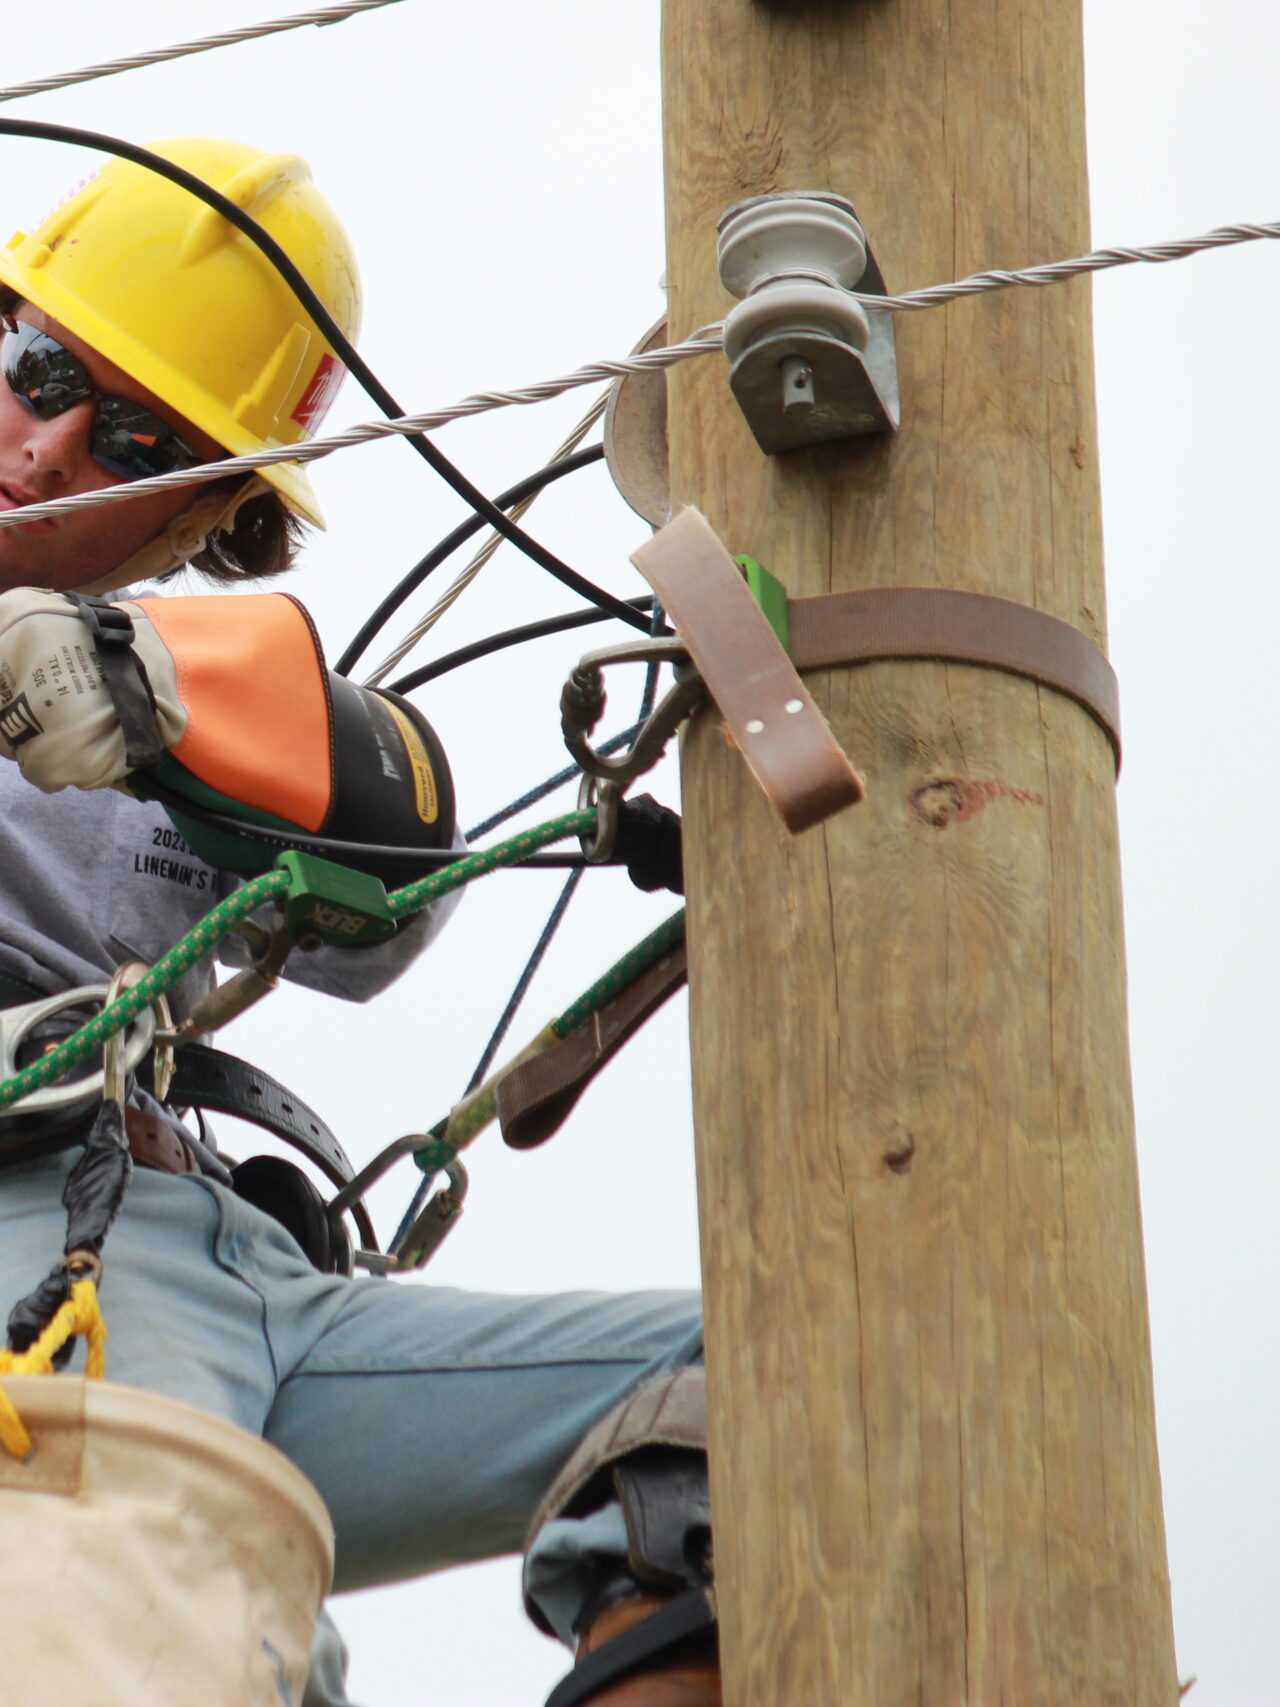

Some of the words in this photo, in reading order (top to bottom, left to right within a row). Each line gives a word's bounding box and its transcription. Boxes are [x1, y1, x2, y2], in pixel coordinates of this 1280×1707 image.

[31, 668, 47, 688] 305
[417, 766, 429, 817] Honeywell
[307, 903, 368, 935] BUCK
